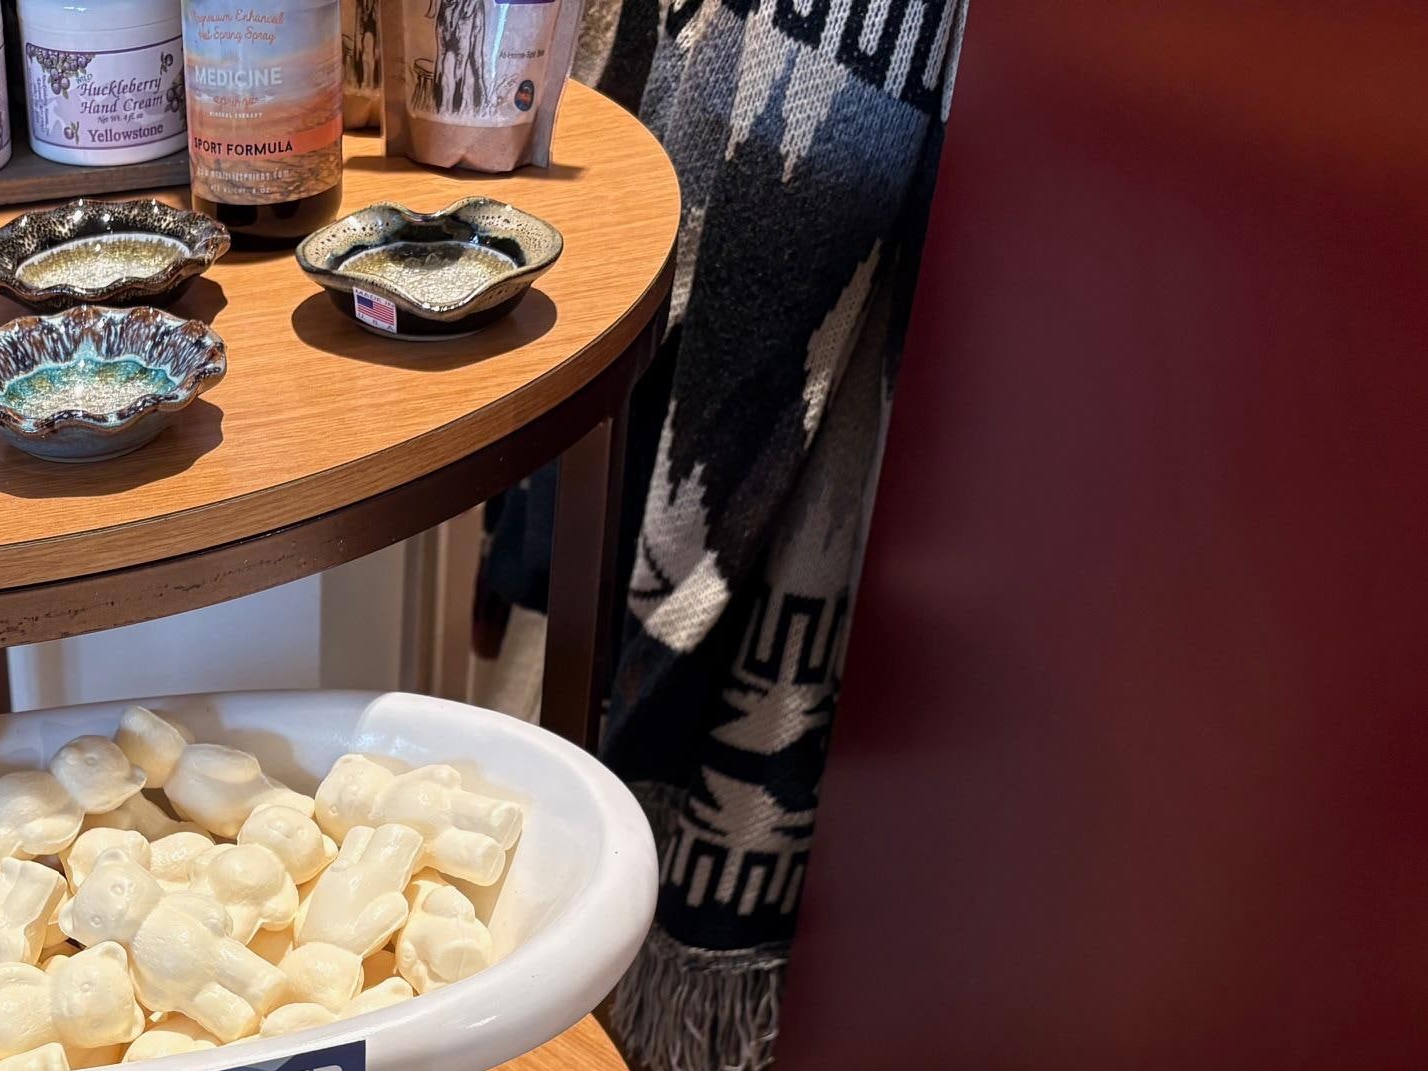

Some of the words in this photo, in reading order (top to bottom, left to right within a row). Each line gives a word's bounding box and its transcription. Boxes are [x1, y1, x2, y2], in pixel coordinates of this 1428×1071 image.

[213, 27, 243, 44] Spring
[244, 26, 277, 45] Spray
[194, 65, 283, 88] MEDICINE
[77, 76, 163, 101] Huckleberry
[80, 98, 118, 114] Hand
[123, 95, 164, 111] Cream
[87, 123, 164, 143] Yellowstone
[194, 137, 223, 154] SPORT
[226, 140, 294, 157] FORMULA
